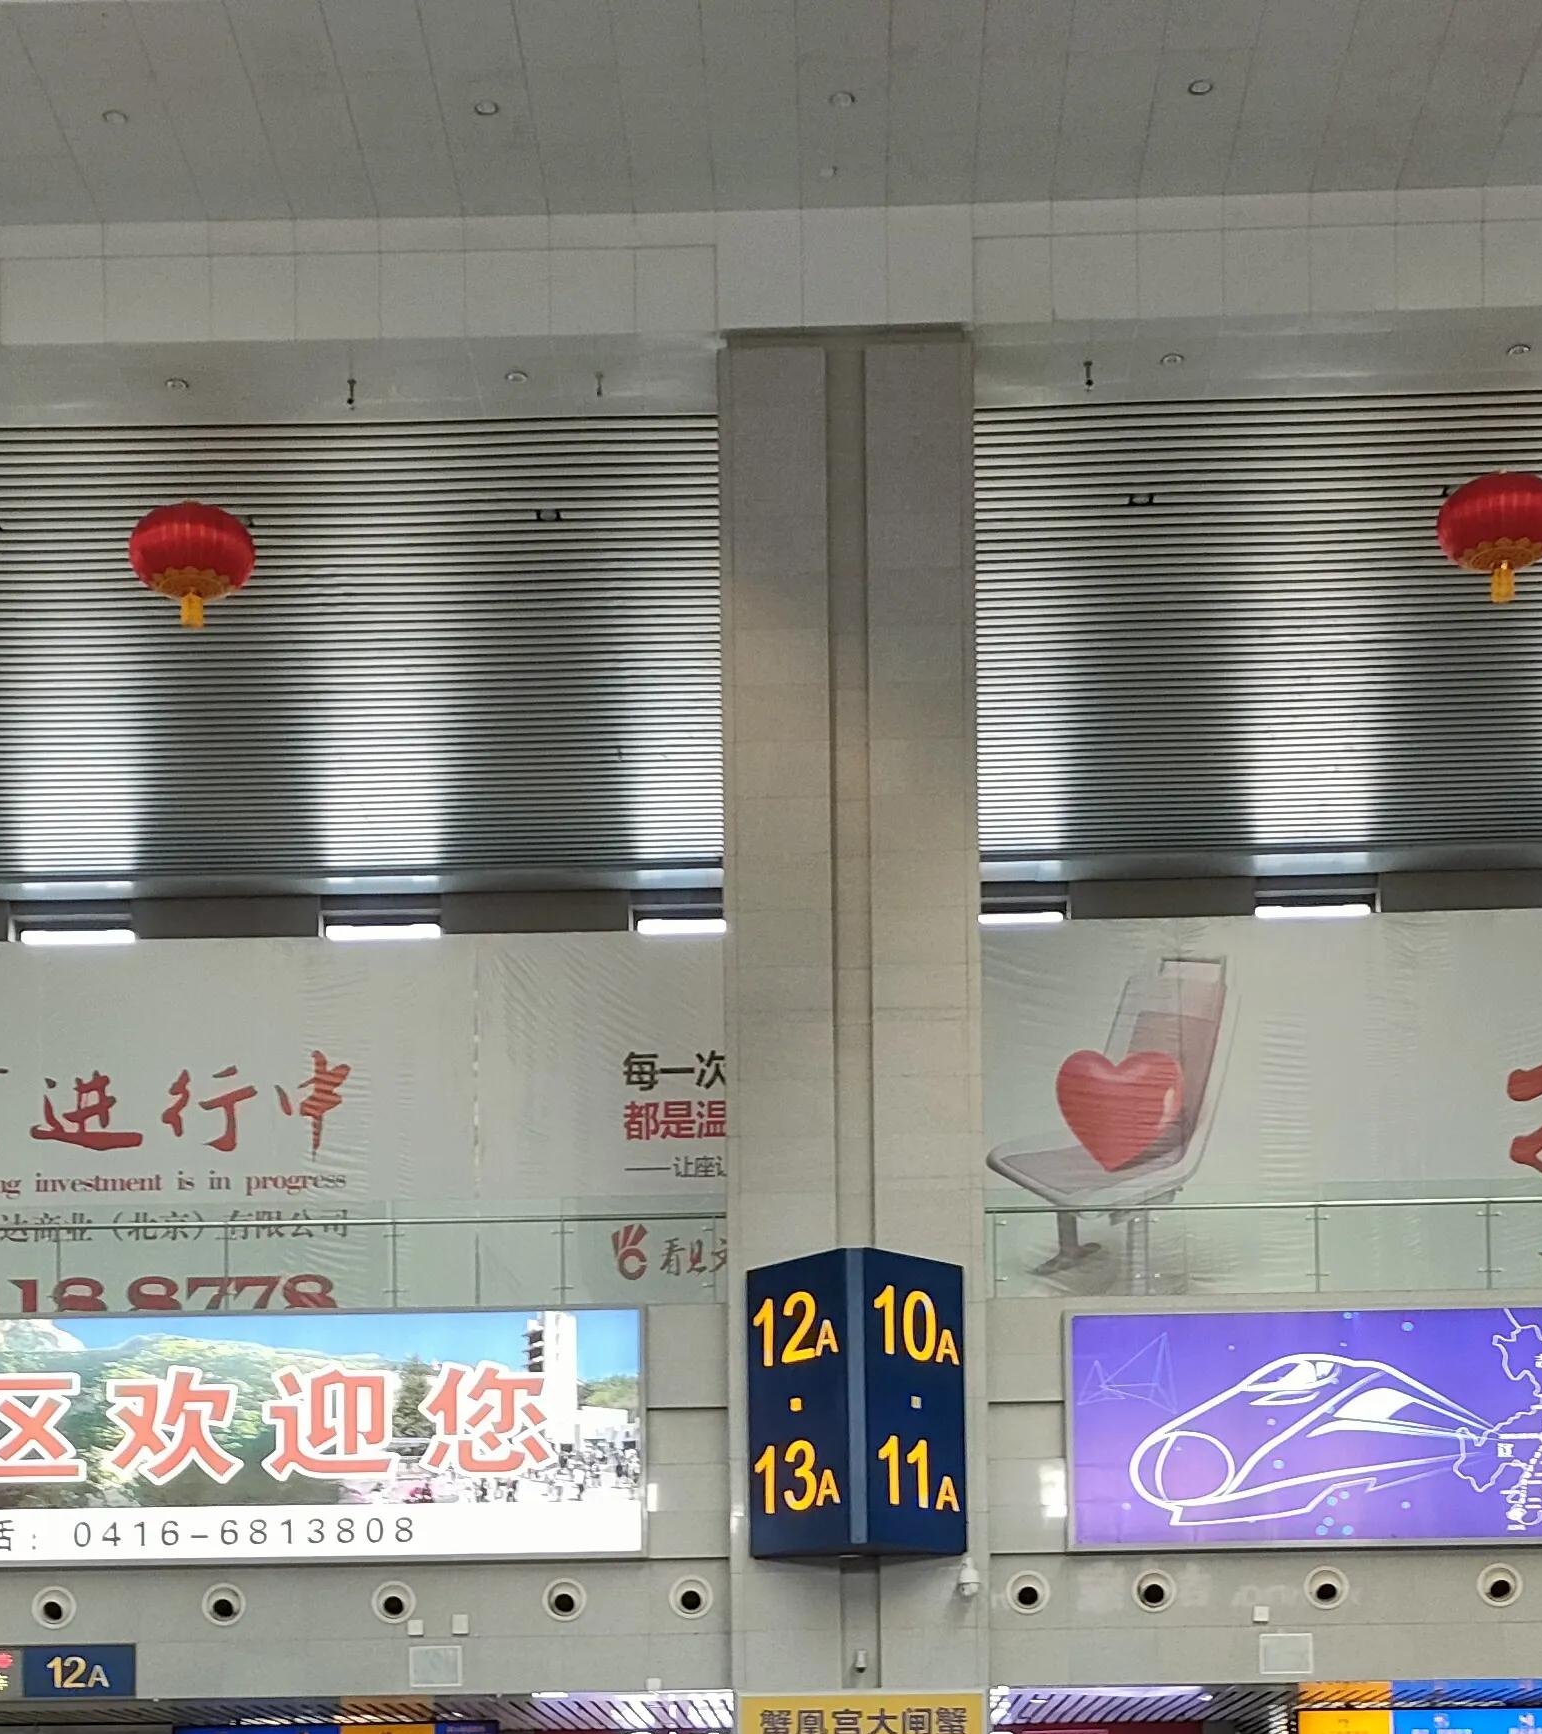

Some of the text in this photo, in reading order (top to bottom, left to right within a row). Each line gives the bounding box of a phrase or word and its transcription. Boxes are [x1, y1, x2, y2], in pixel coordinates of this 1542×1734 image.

[623, 1100, 726, 1140] 都是温
[35, 1172, 161, 1194] investment
[177, 1170, 195, 1191] is
[209, 1171, 231, 1191] in
[245, 1172, 347, 1197] progress
[752, 1290, 840, 1368] 12A
[873, 1284, 960, 1367] 10A
[754, 1439, 842, 1516] 13A
[877, 1434, 960, 1513] 11A
[72, 1516, 416, 1548] 0416-6813808
[46, 1656, 110, 1689] 12A
